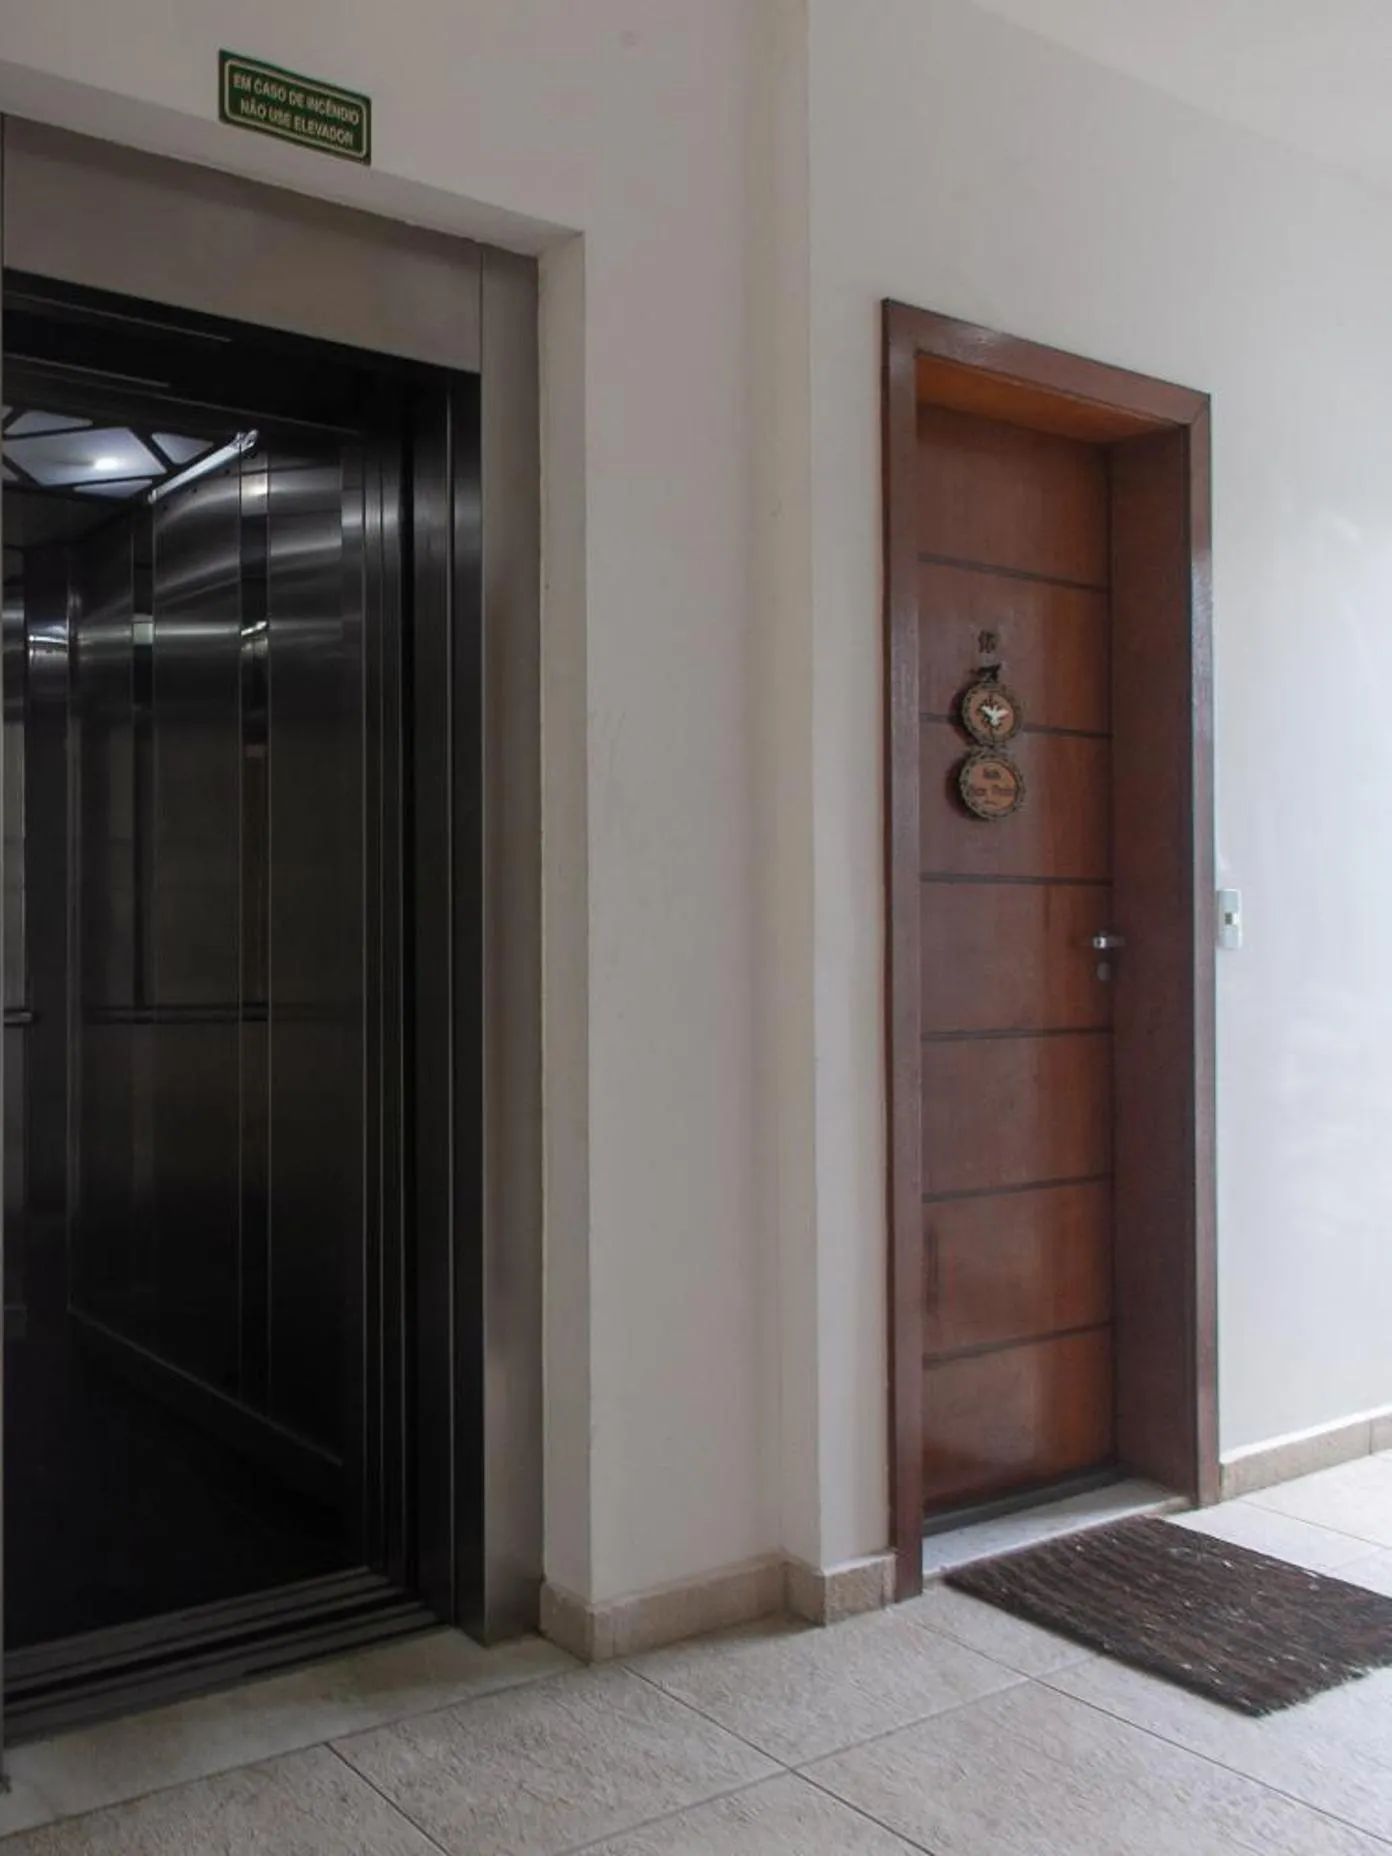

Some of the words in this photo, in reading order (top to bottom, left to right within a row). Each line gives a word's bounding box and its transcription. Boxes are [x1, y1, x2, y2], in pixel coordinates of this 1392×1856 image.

[233, 73, 251, 91] EM
[254, 78, 287, 101] CASO
[288, 91, 305, 108] DE
[240, 98, 266, 120] NÃO
[268, 107, 292, 127] USE
[294, 115, 353, 145] ELEVADOR
